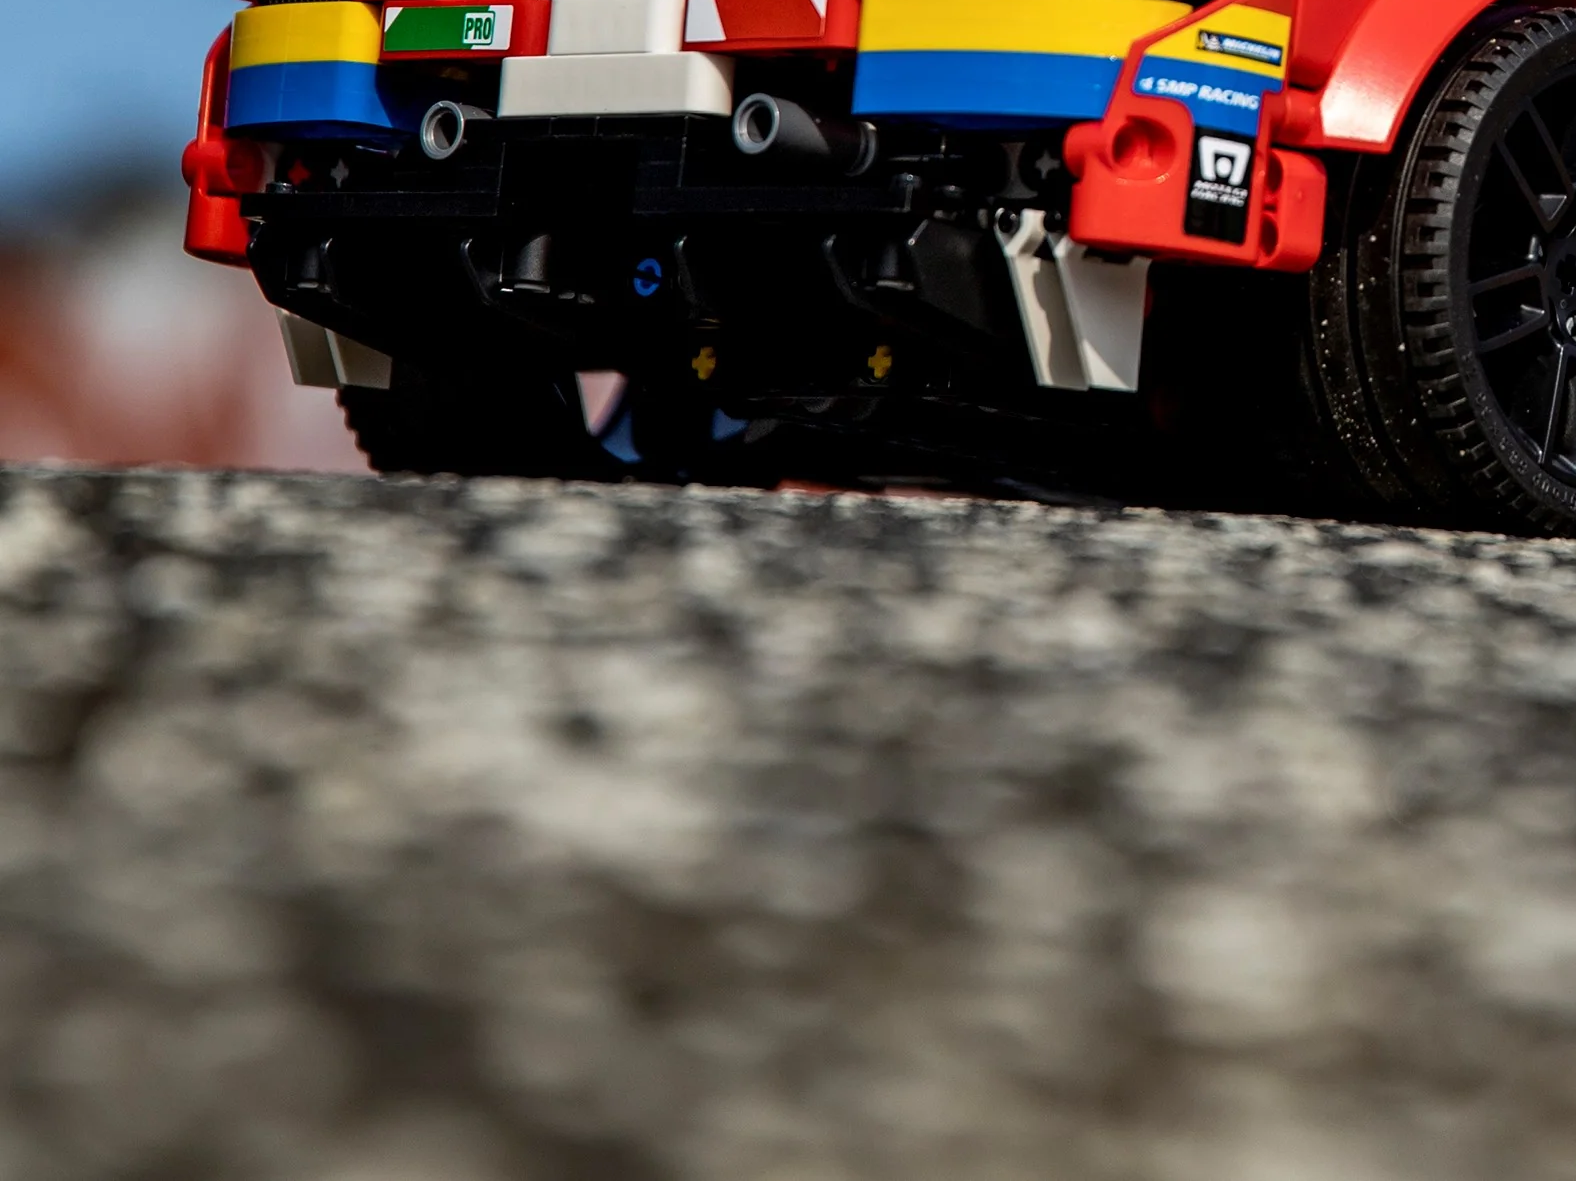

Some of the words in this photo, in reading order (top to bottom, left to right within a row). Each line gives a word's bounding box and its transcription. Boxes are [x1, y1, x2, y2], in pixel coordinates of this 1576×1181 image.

[464, 16, 492, 40] PRO
[1156, 77, 1198, 98] SMP
[1198, 84, 1261, 110] RACING
